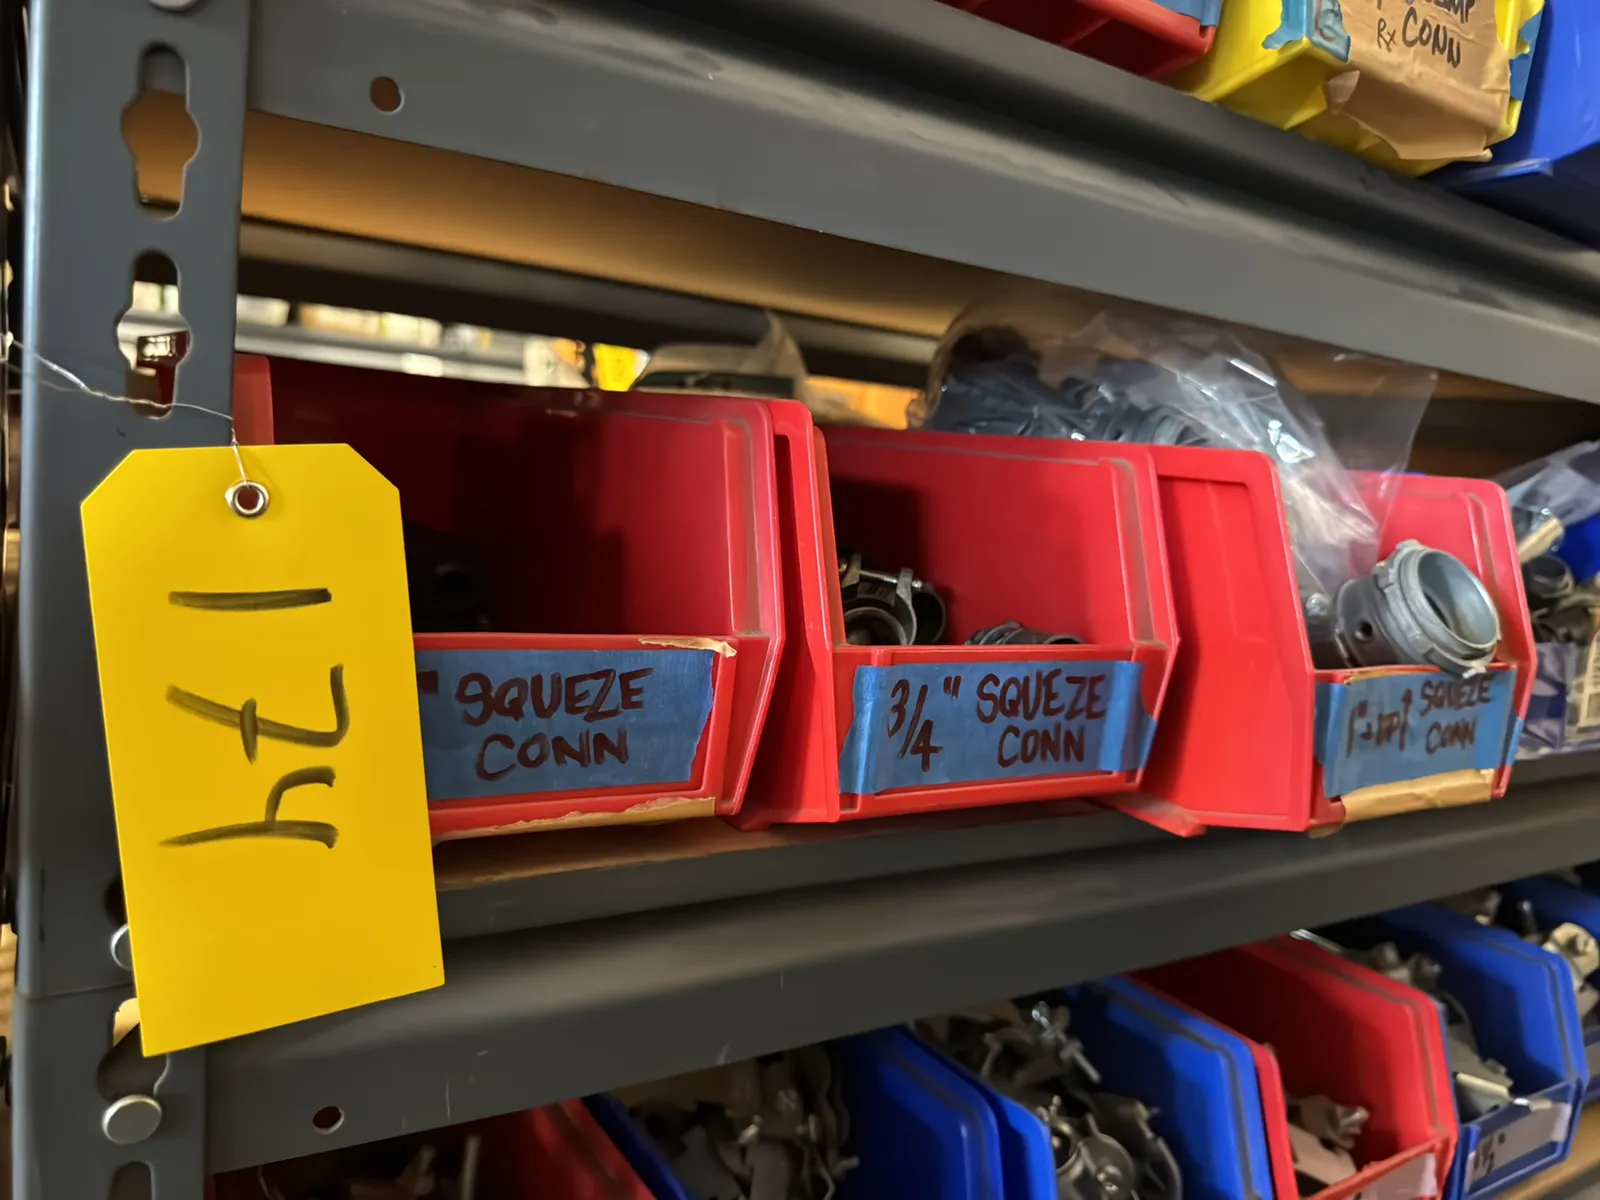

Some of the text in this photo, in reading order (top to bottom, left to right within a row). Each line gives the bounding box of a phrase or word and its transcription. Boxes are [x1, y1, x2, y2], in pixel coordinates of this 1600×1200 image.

[1402, 6, 1461, 69] CONN
[157, 587, 351, 849] 174
[455, 667, 654, 726] SQUEZE
[976, 668, 1108, 723] SQUEZE
[475, 727, 630, 781] CONN
[997, 723, 1086, 768] CONN
